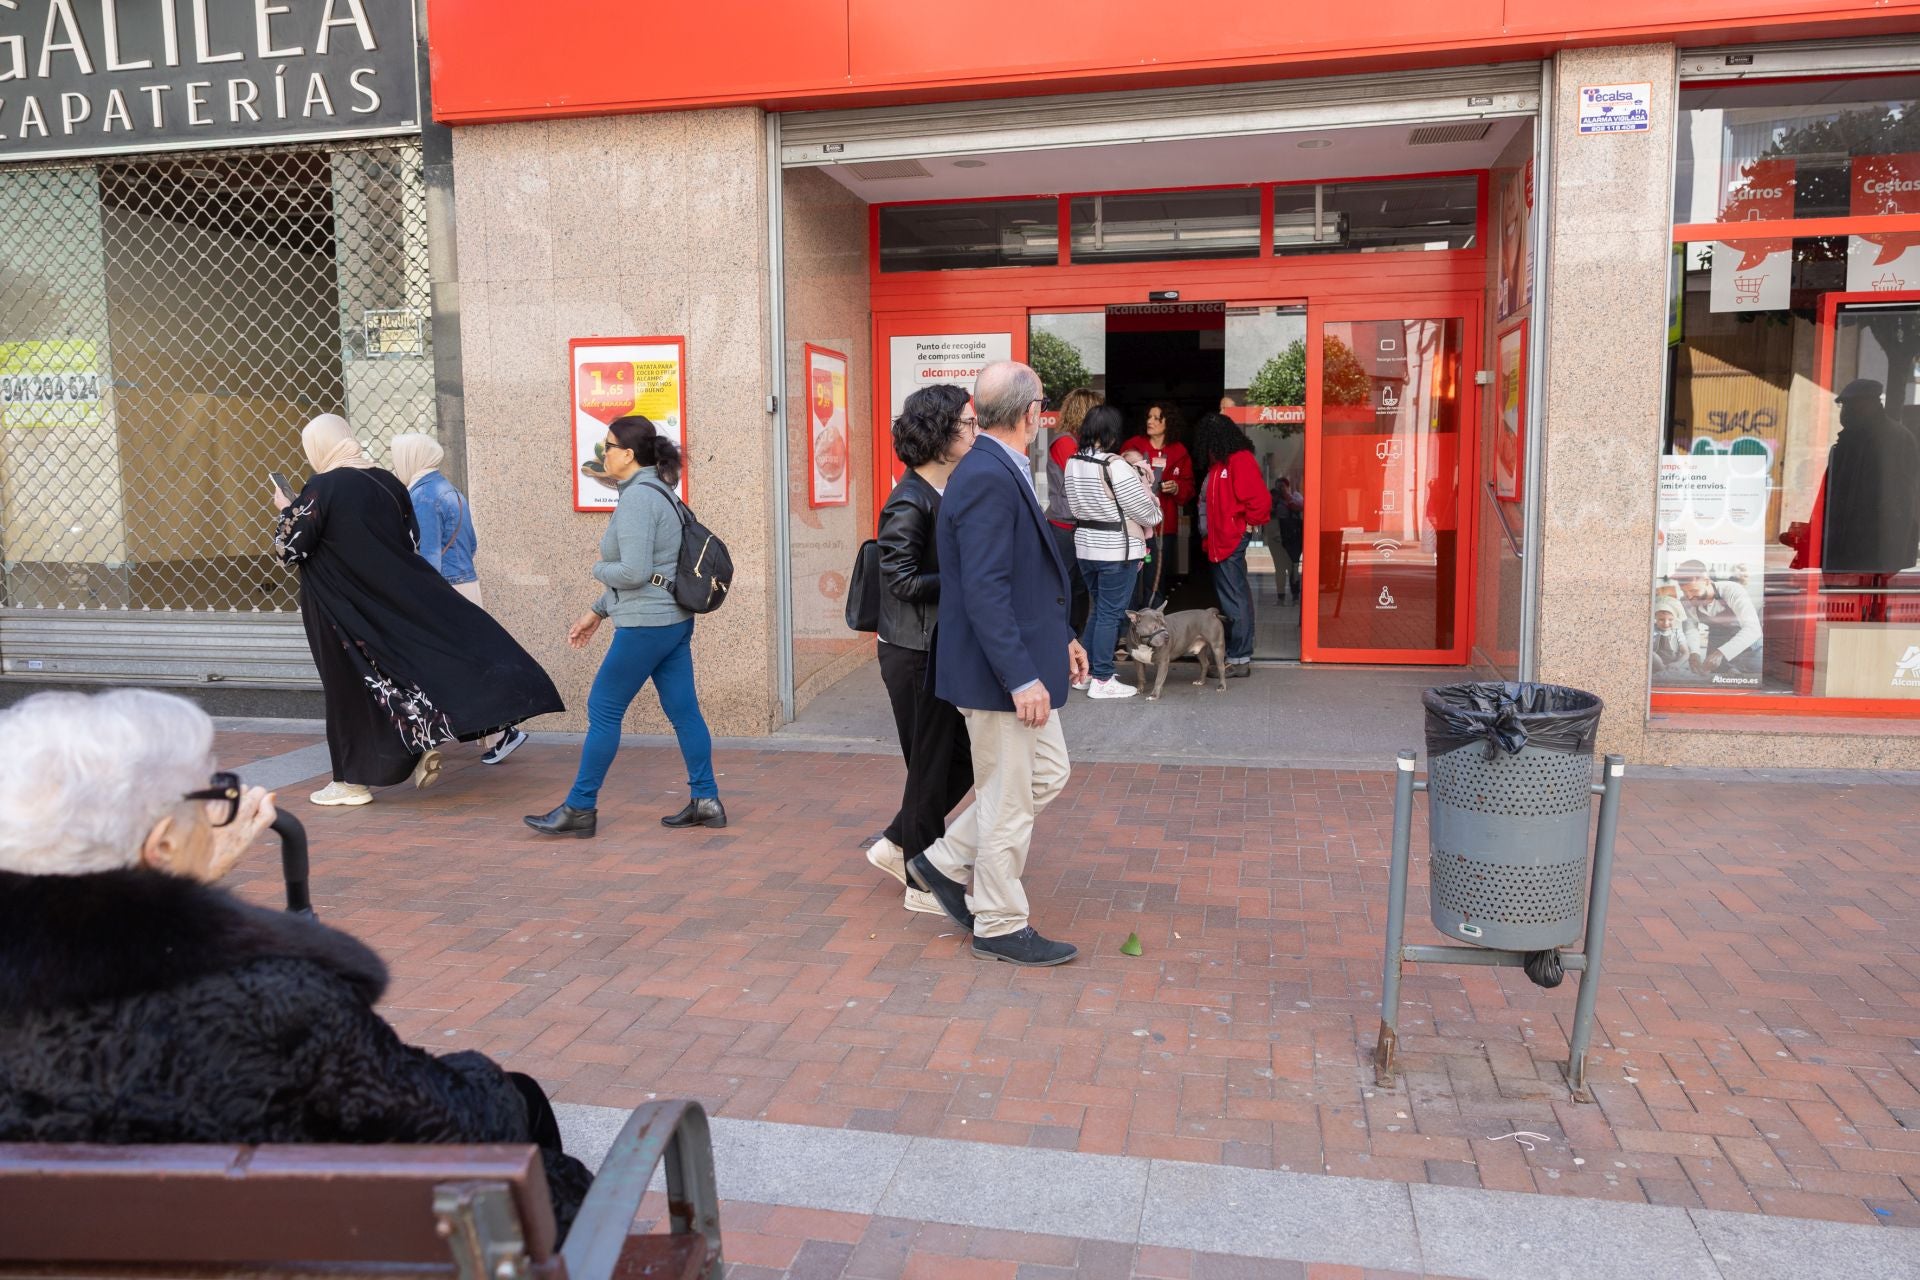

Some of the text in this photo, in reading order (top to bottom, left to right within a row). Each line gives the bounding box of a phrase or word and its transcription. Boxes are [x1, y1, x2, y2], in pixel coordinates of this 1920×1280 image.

[1583, 89, 1633, 102] Tecalsa
[0, 64, 382, 140] APATERÍAS
[1584, 116, 1612, 124] ALARMA
[1863, 178, 1920, 194] Cestas
[916, 341, 987, 352] Punto de recogida
[917, 351, 985, 362] de compras online
[1712, 674, 1759, 685] Alcampo.es
